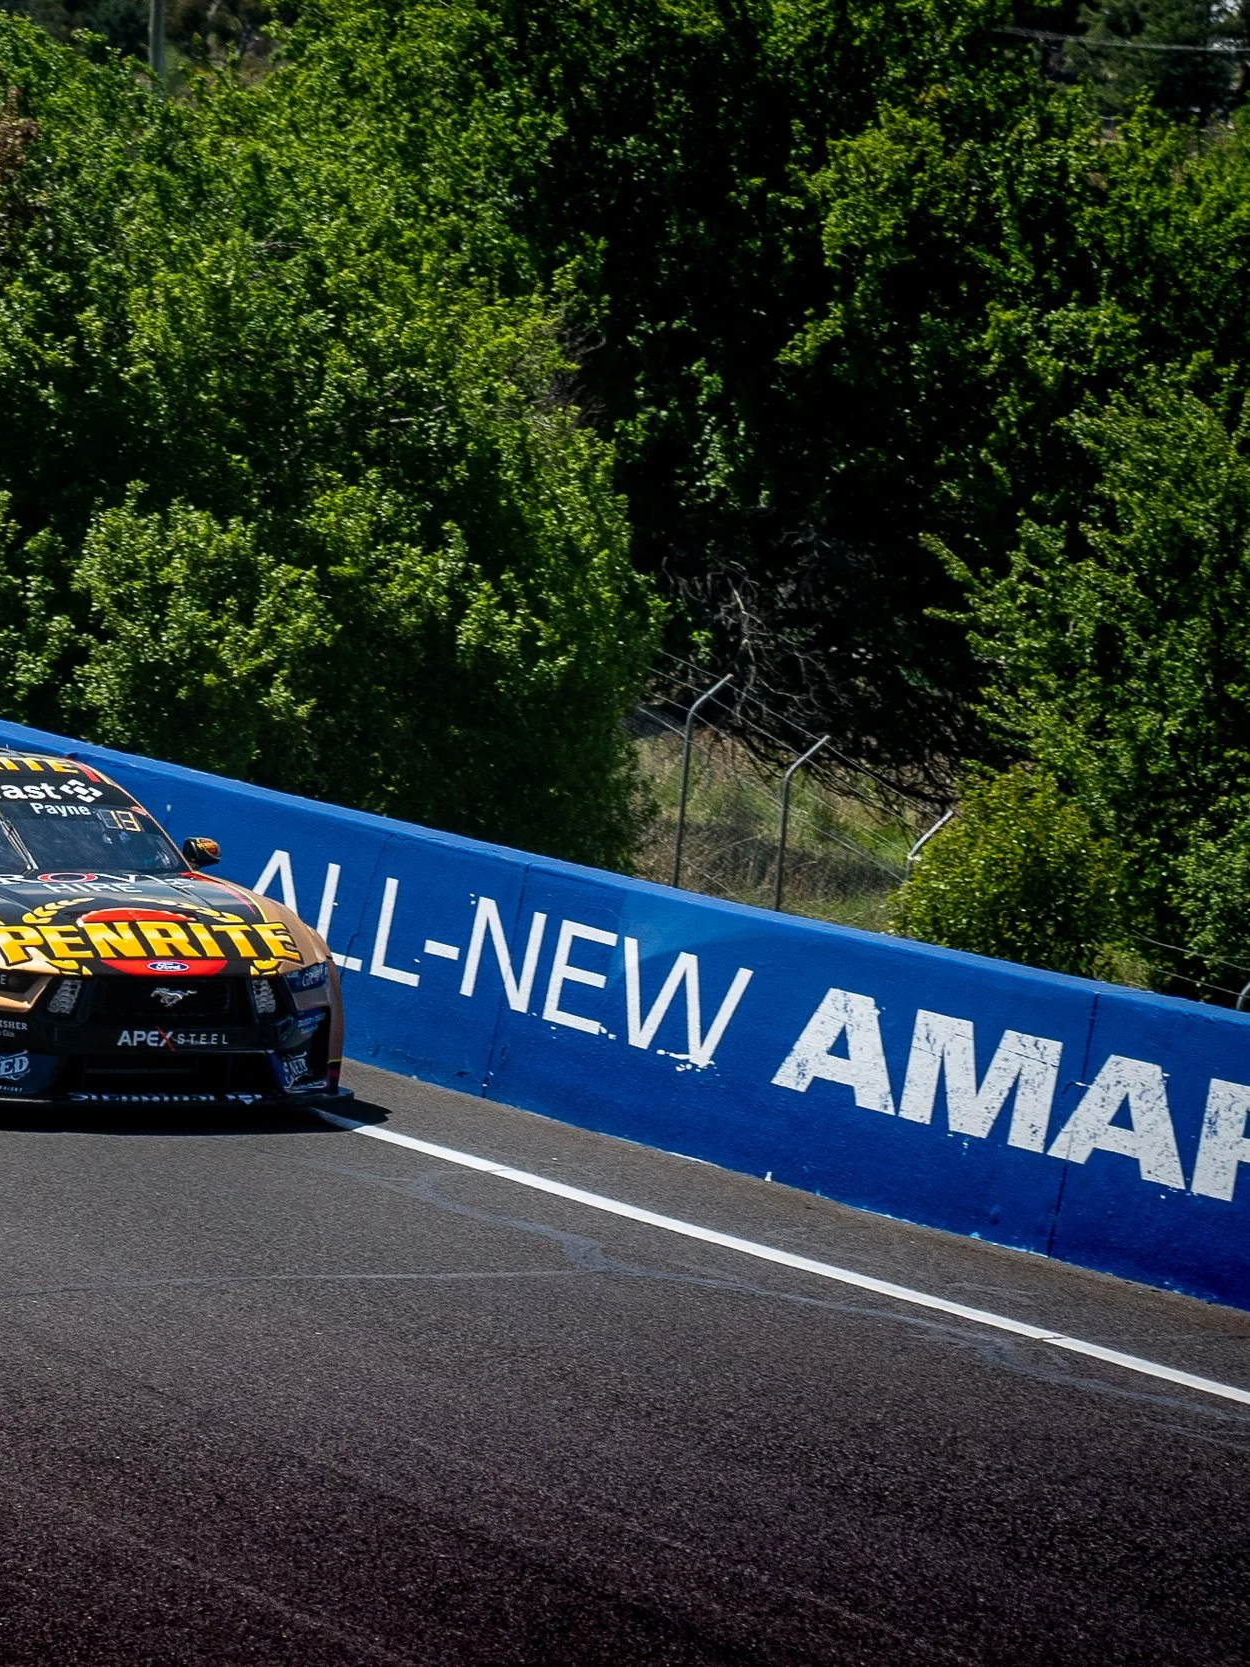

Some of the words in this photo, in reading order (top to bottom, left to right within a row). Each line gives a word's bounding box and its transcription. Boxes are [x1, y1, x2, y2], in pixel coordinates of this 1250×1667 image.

[30, 802, 92, 817] Payne
[44, 883, 143, 893] HIRE
[251, 849, 752, 1067] ALL-NEW
[152, 962, 185, 972] Ford
[117, 1028, 174, 1050] APEX
[177, 1034, 228, 1045] STEEL
